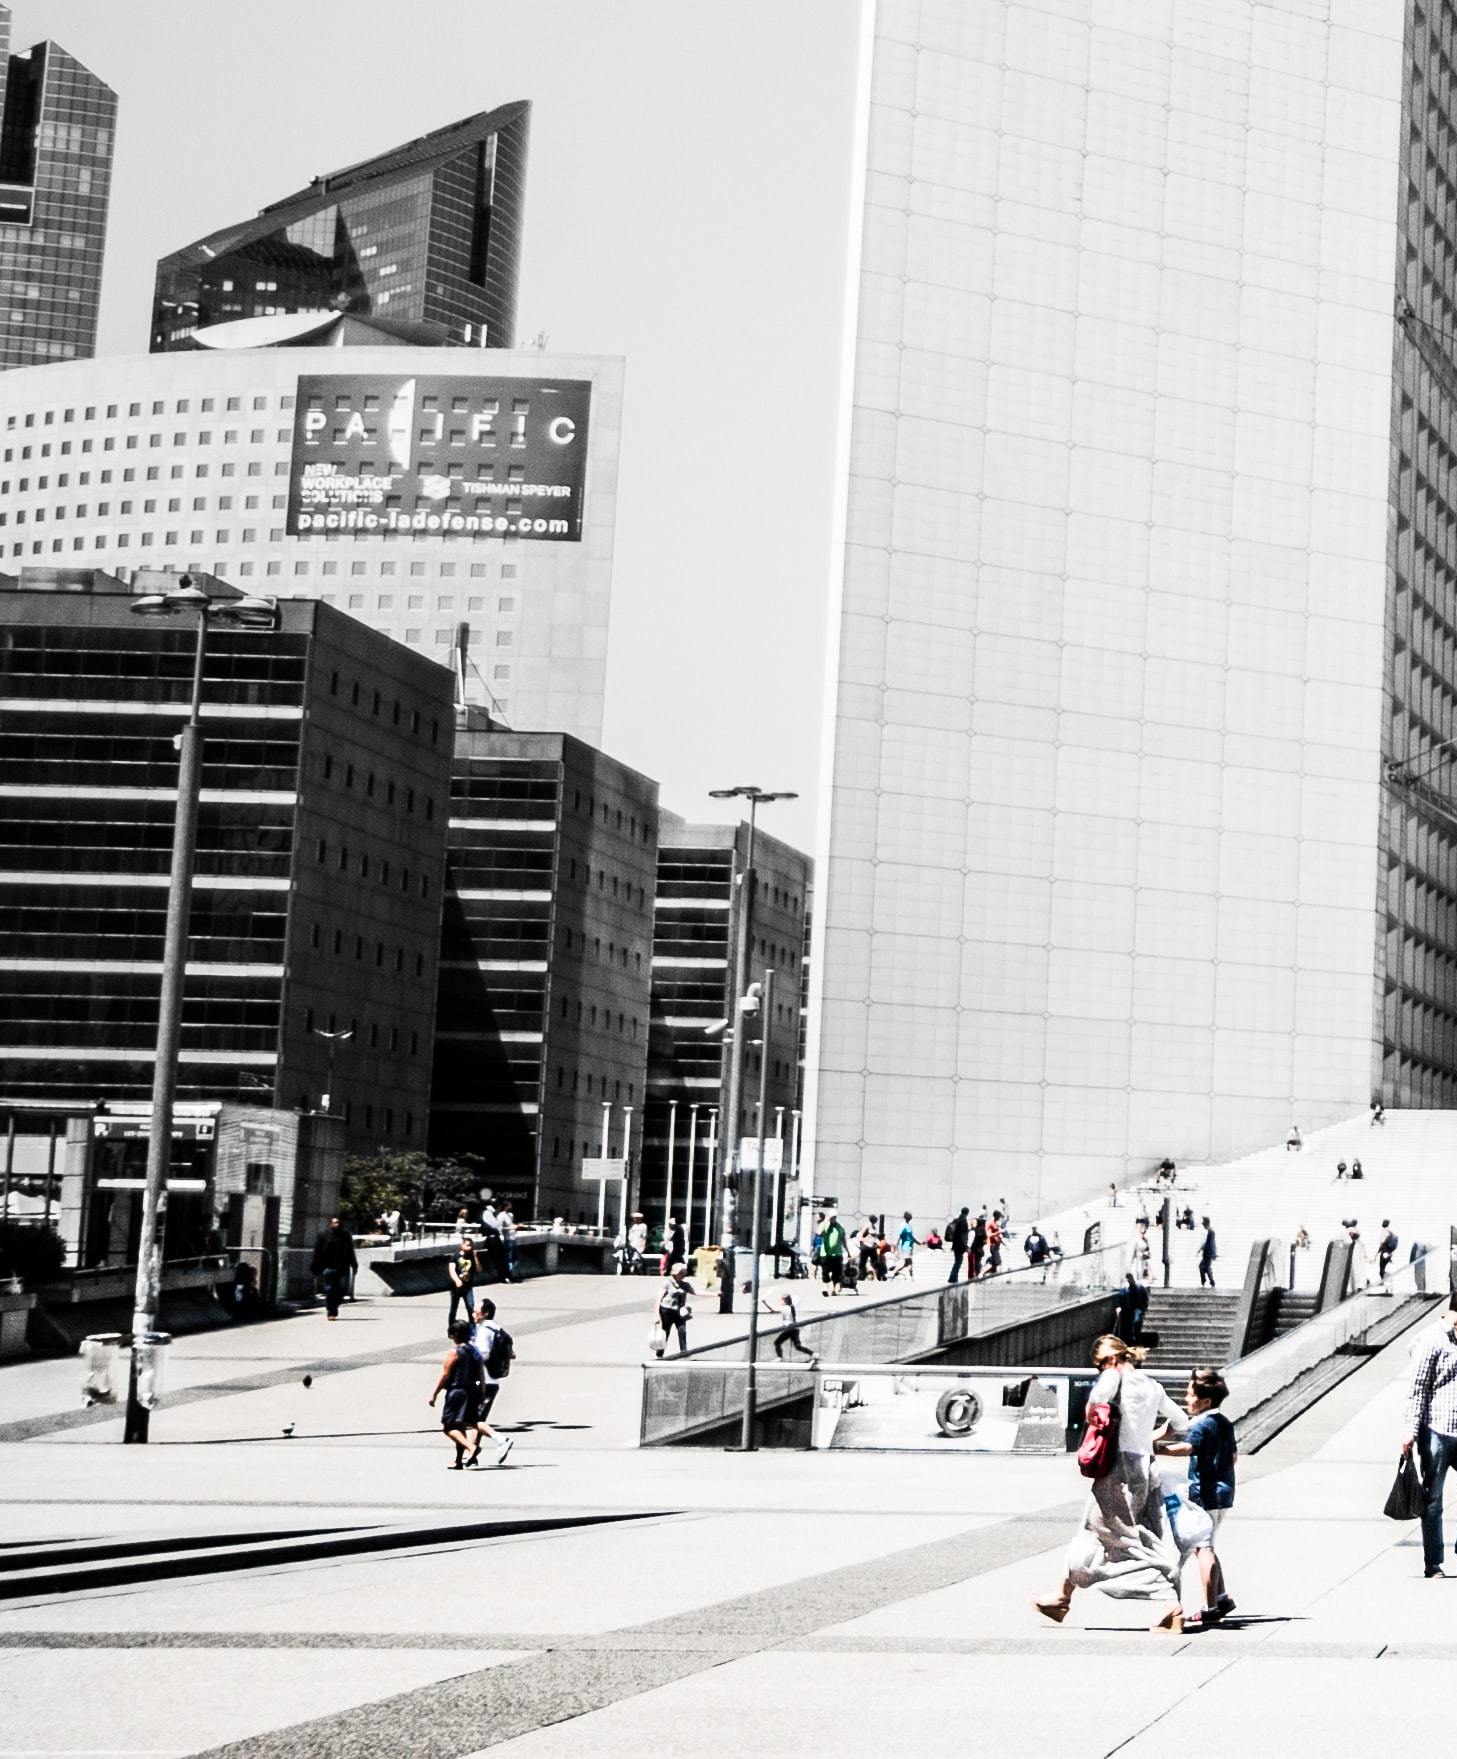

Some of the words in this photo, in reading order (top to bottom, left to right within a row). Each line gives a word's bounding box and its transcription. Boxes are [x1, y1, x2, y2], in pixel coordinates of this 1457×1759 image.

[304, 463, 338, 476] NEW
[301, 476, 393, 490] WORKPLACE
[462, 482, 520, 495] TISHMAN
[521, 484, 571, 497] SPEYER
[301, 490, 384, 504] SOLUTIONS
[298, 510, 569, 533] pacific-ladefense.com
